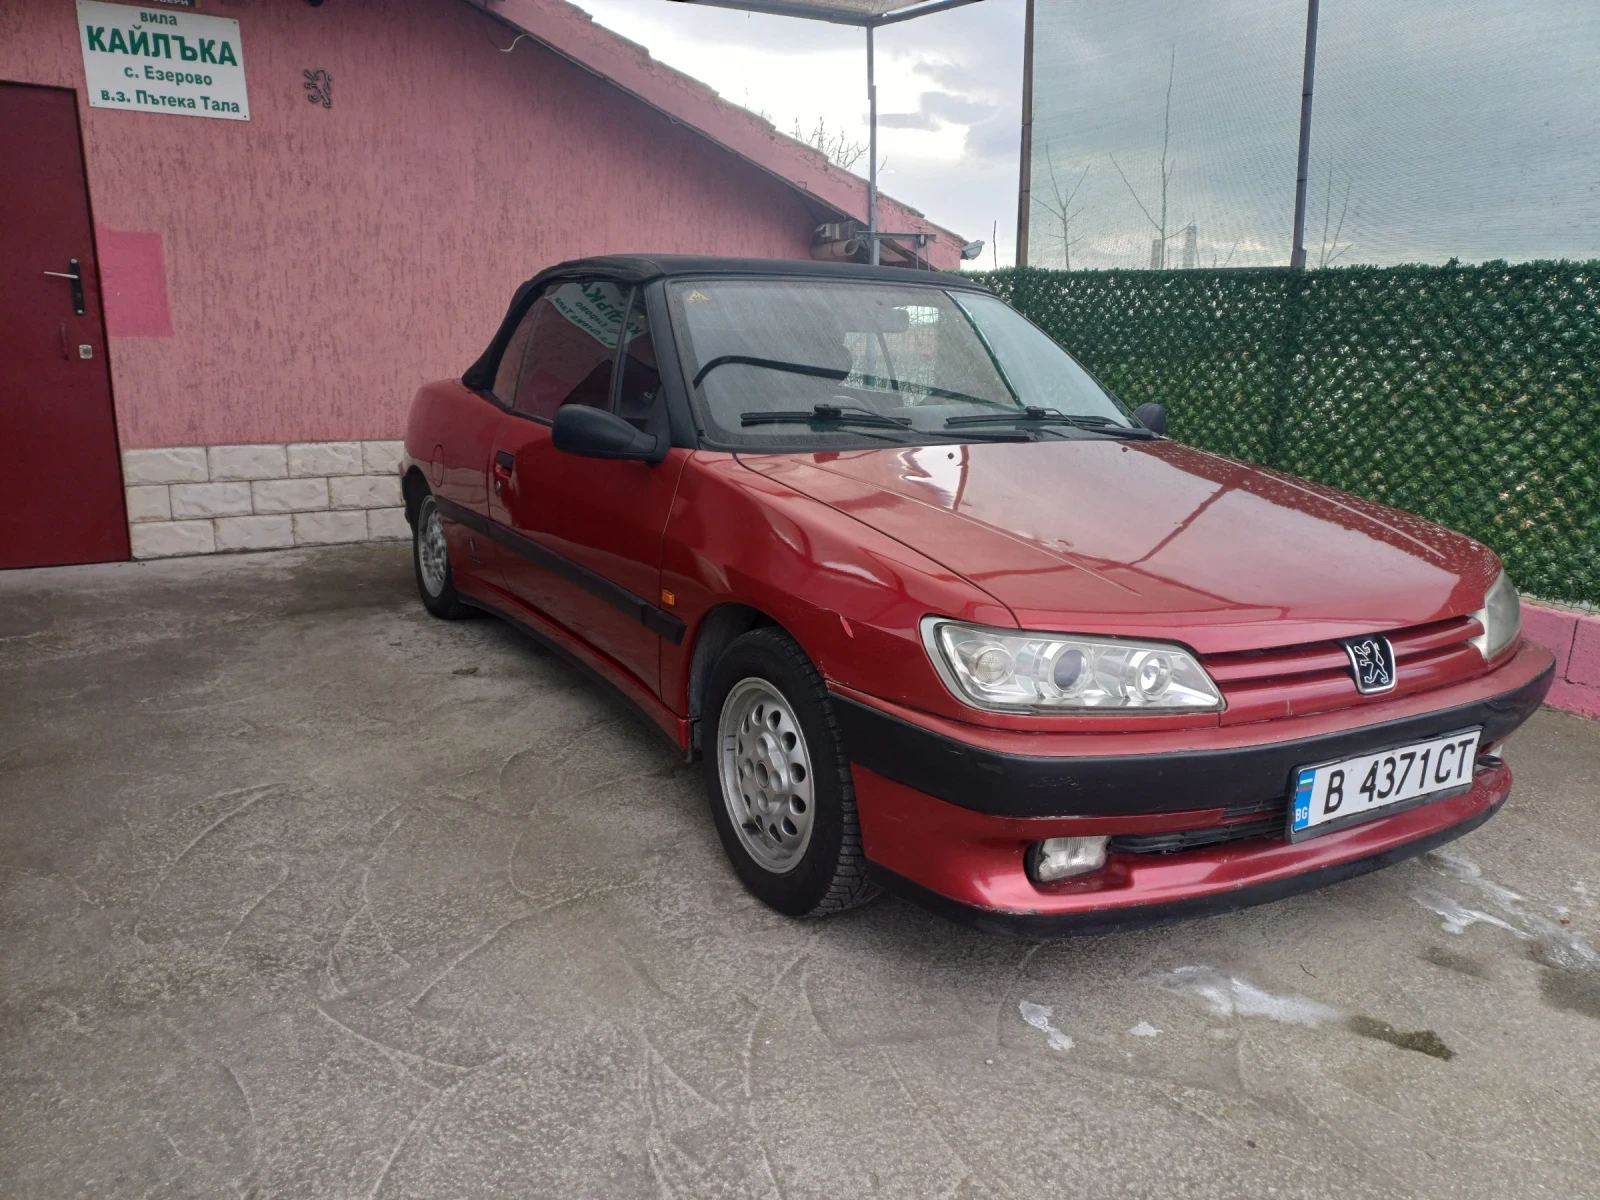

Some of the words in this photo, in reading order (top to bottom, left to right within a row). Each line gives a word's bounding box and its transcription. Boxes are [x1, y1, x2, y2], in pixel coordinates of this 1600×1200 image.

[140, 12, 178, 26] вила
[86, 24, 238, 67] КАЙЛЪКА
[124, 66, 139, 79] с.
[144, 65, 213, 86] Езерово
[101, 89, 131, 103] в.з.
[136, 89, 196, 109] Пътека
[200, 96, 240, 113] Тала
[1323, 769, 1345, 815] B
[1295, 807, 1308, 822] BG
